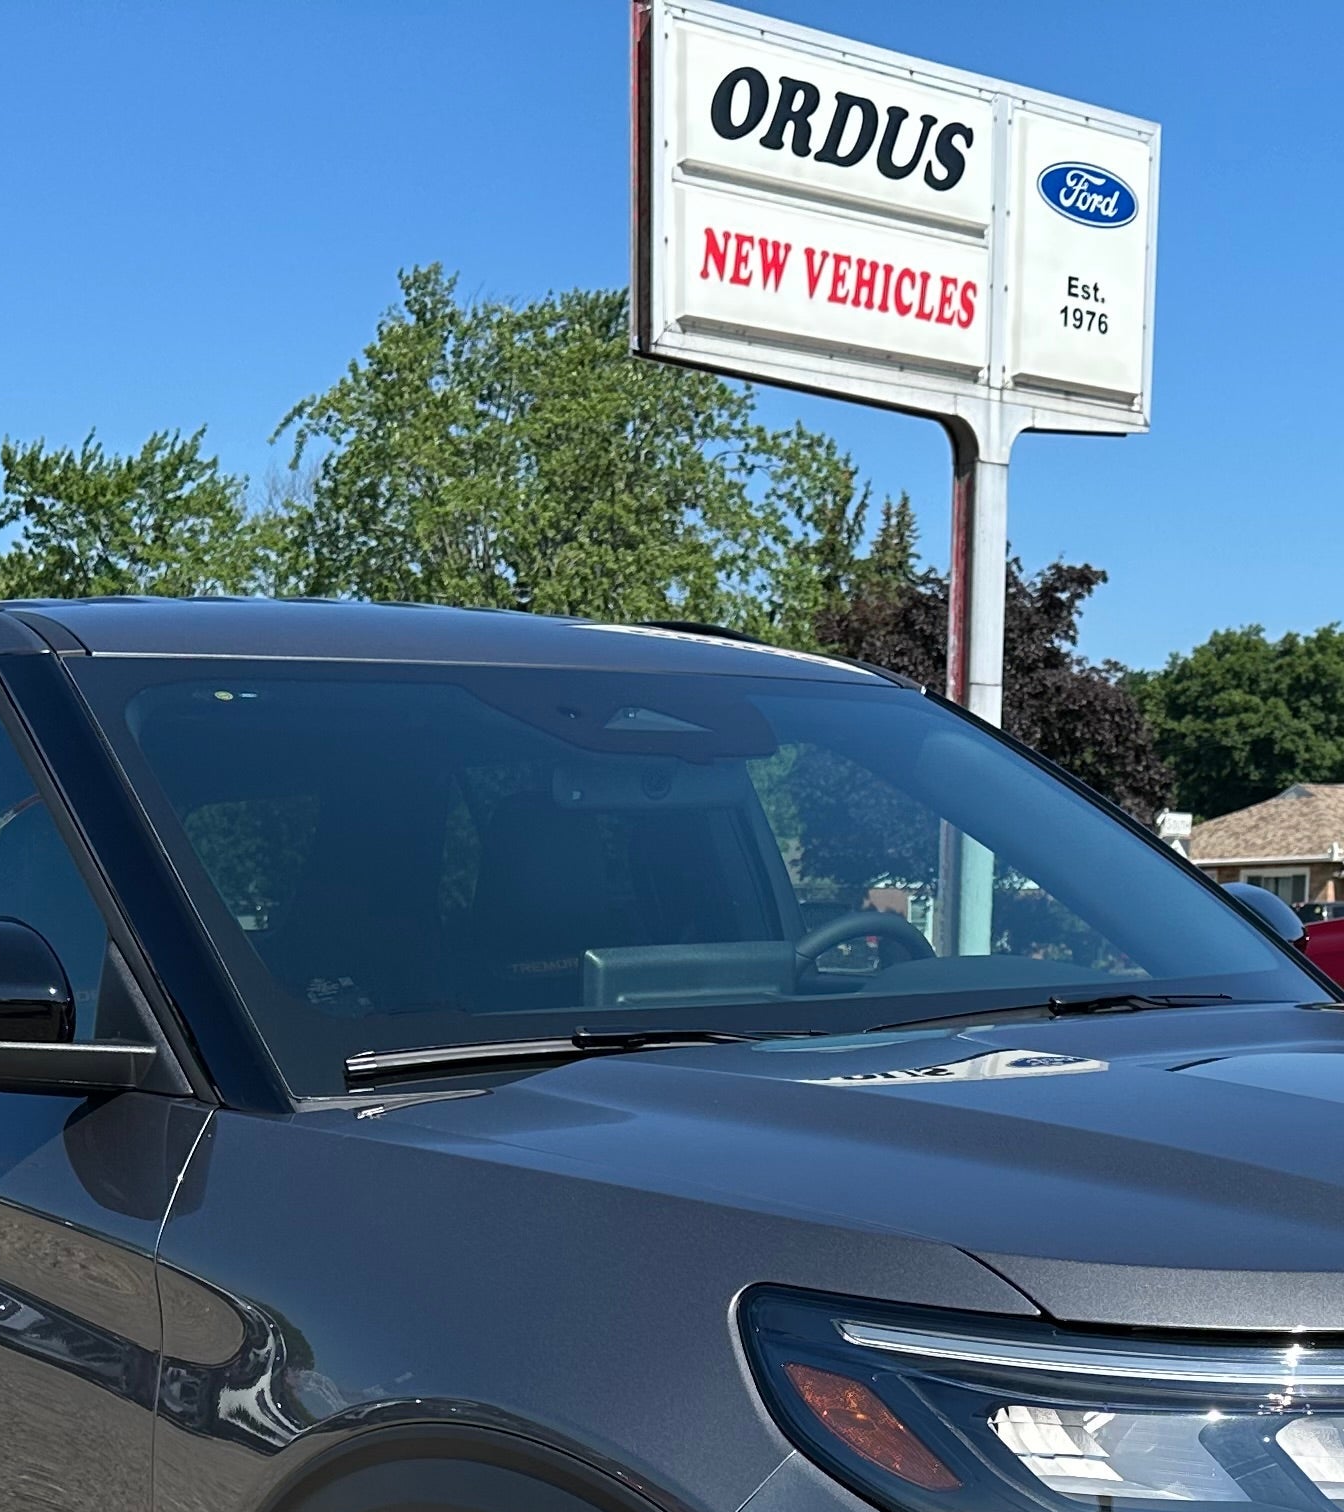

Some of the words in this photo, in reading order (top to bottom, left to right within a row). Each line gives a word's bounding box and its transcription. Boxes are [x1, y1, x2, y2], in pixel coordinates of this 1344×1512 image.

[710, 66, 974, 192] ORDUS
[1059, 169, 1121, 218] Ford
[700, 227, 792, 293] NEW
[804, 247, 978, 329] VEHICLES
[1067, 276, 1106, 303] Est.
[1060, 305, 1109, 335] 1976
